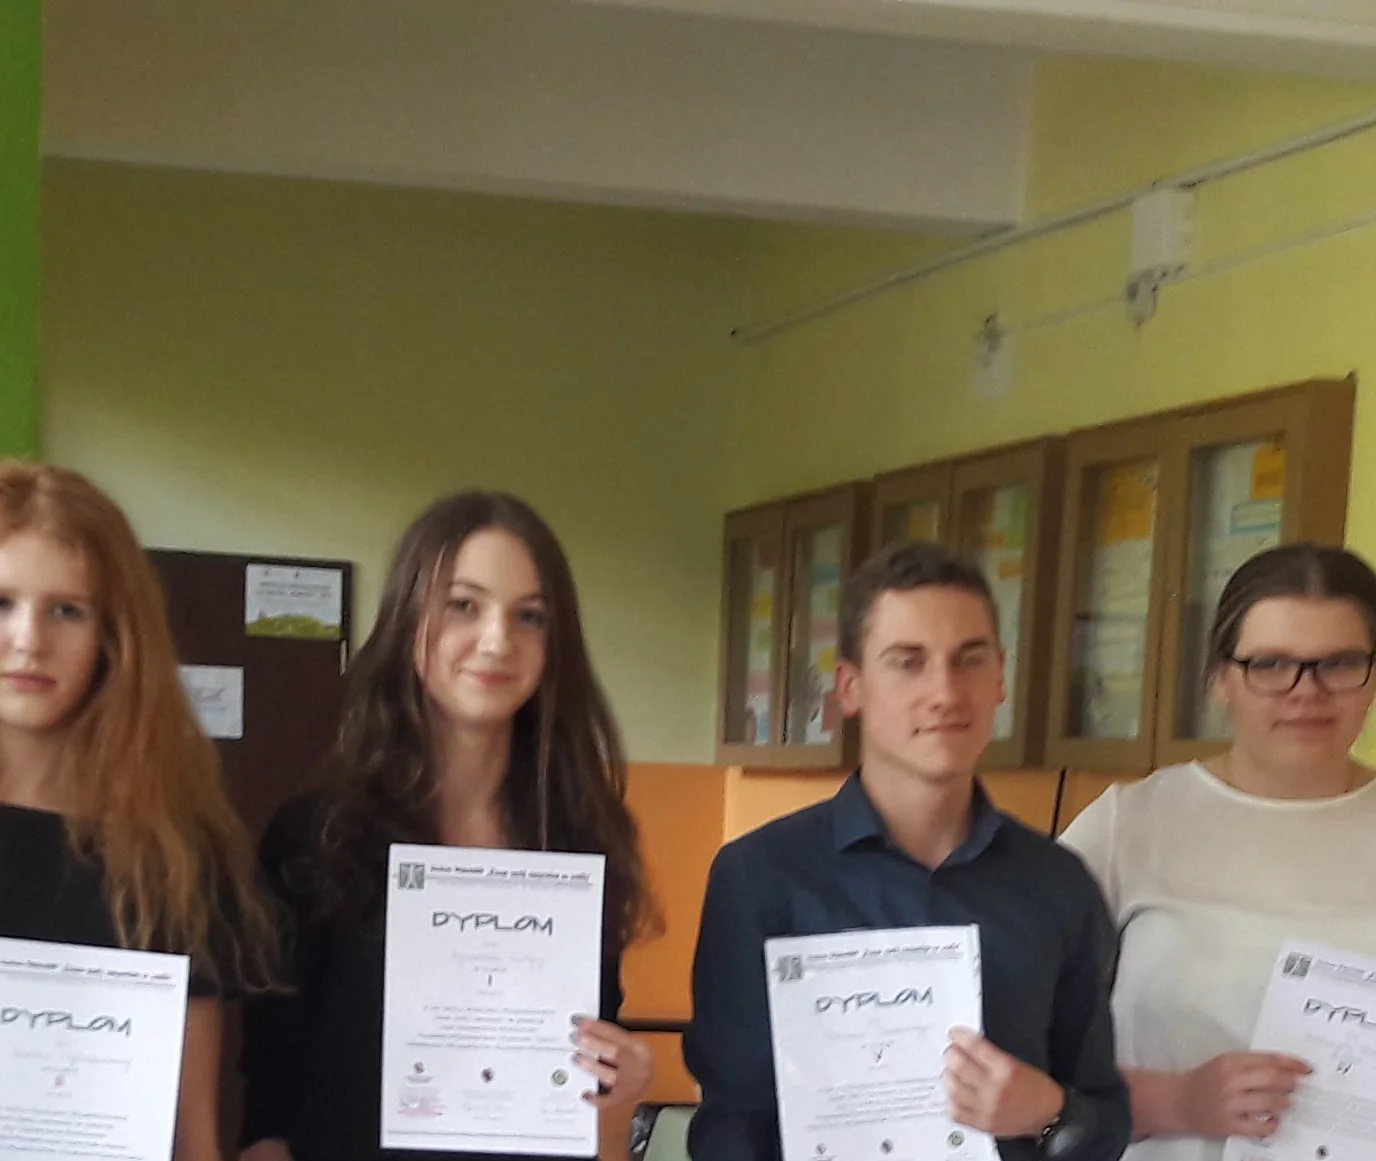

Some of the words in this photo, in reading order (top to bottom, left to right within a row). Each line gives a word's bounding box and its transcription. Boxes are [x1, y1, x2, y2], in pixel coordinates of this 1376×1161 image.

[431, 911, 554, 936] DYPLOM
[815, 985, 934, 1014] DYPLOM
[0, 1006, 133, 1037] DYPLOM
